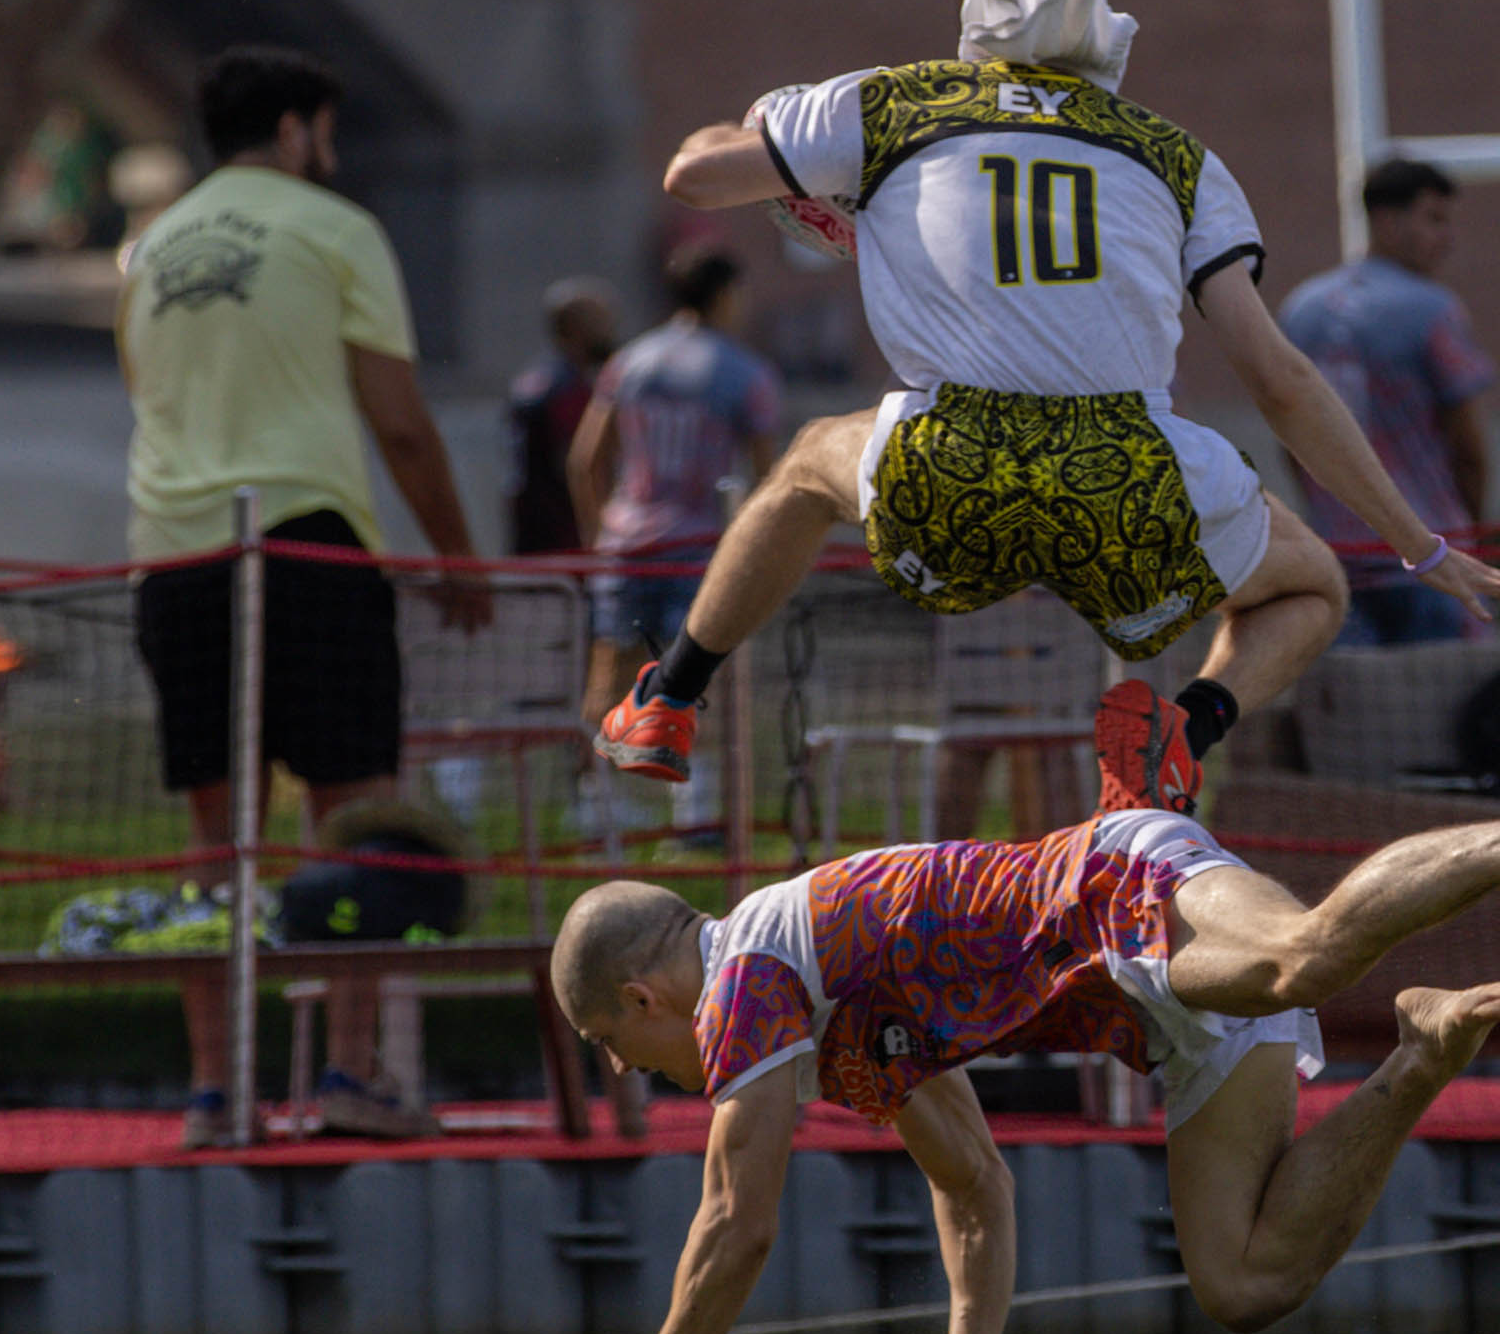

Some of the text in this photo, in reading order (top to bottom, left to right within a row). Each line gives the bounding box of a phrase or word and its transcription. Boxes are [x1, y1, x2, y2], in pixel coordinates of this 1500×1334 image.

[998, 82, 1071, 116] EY
[979, 153, 1101, 288] 10
[893, 549, 947, 595] EY
